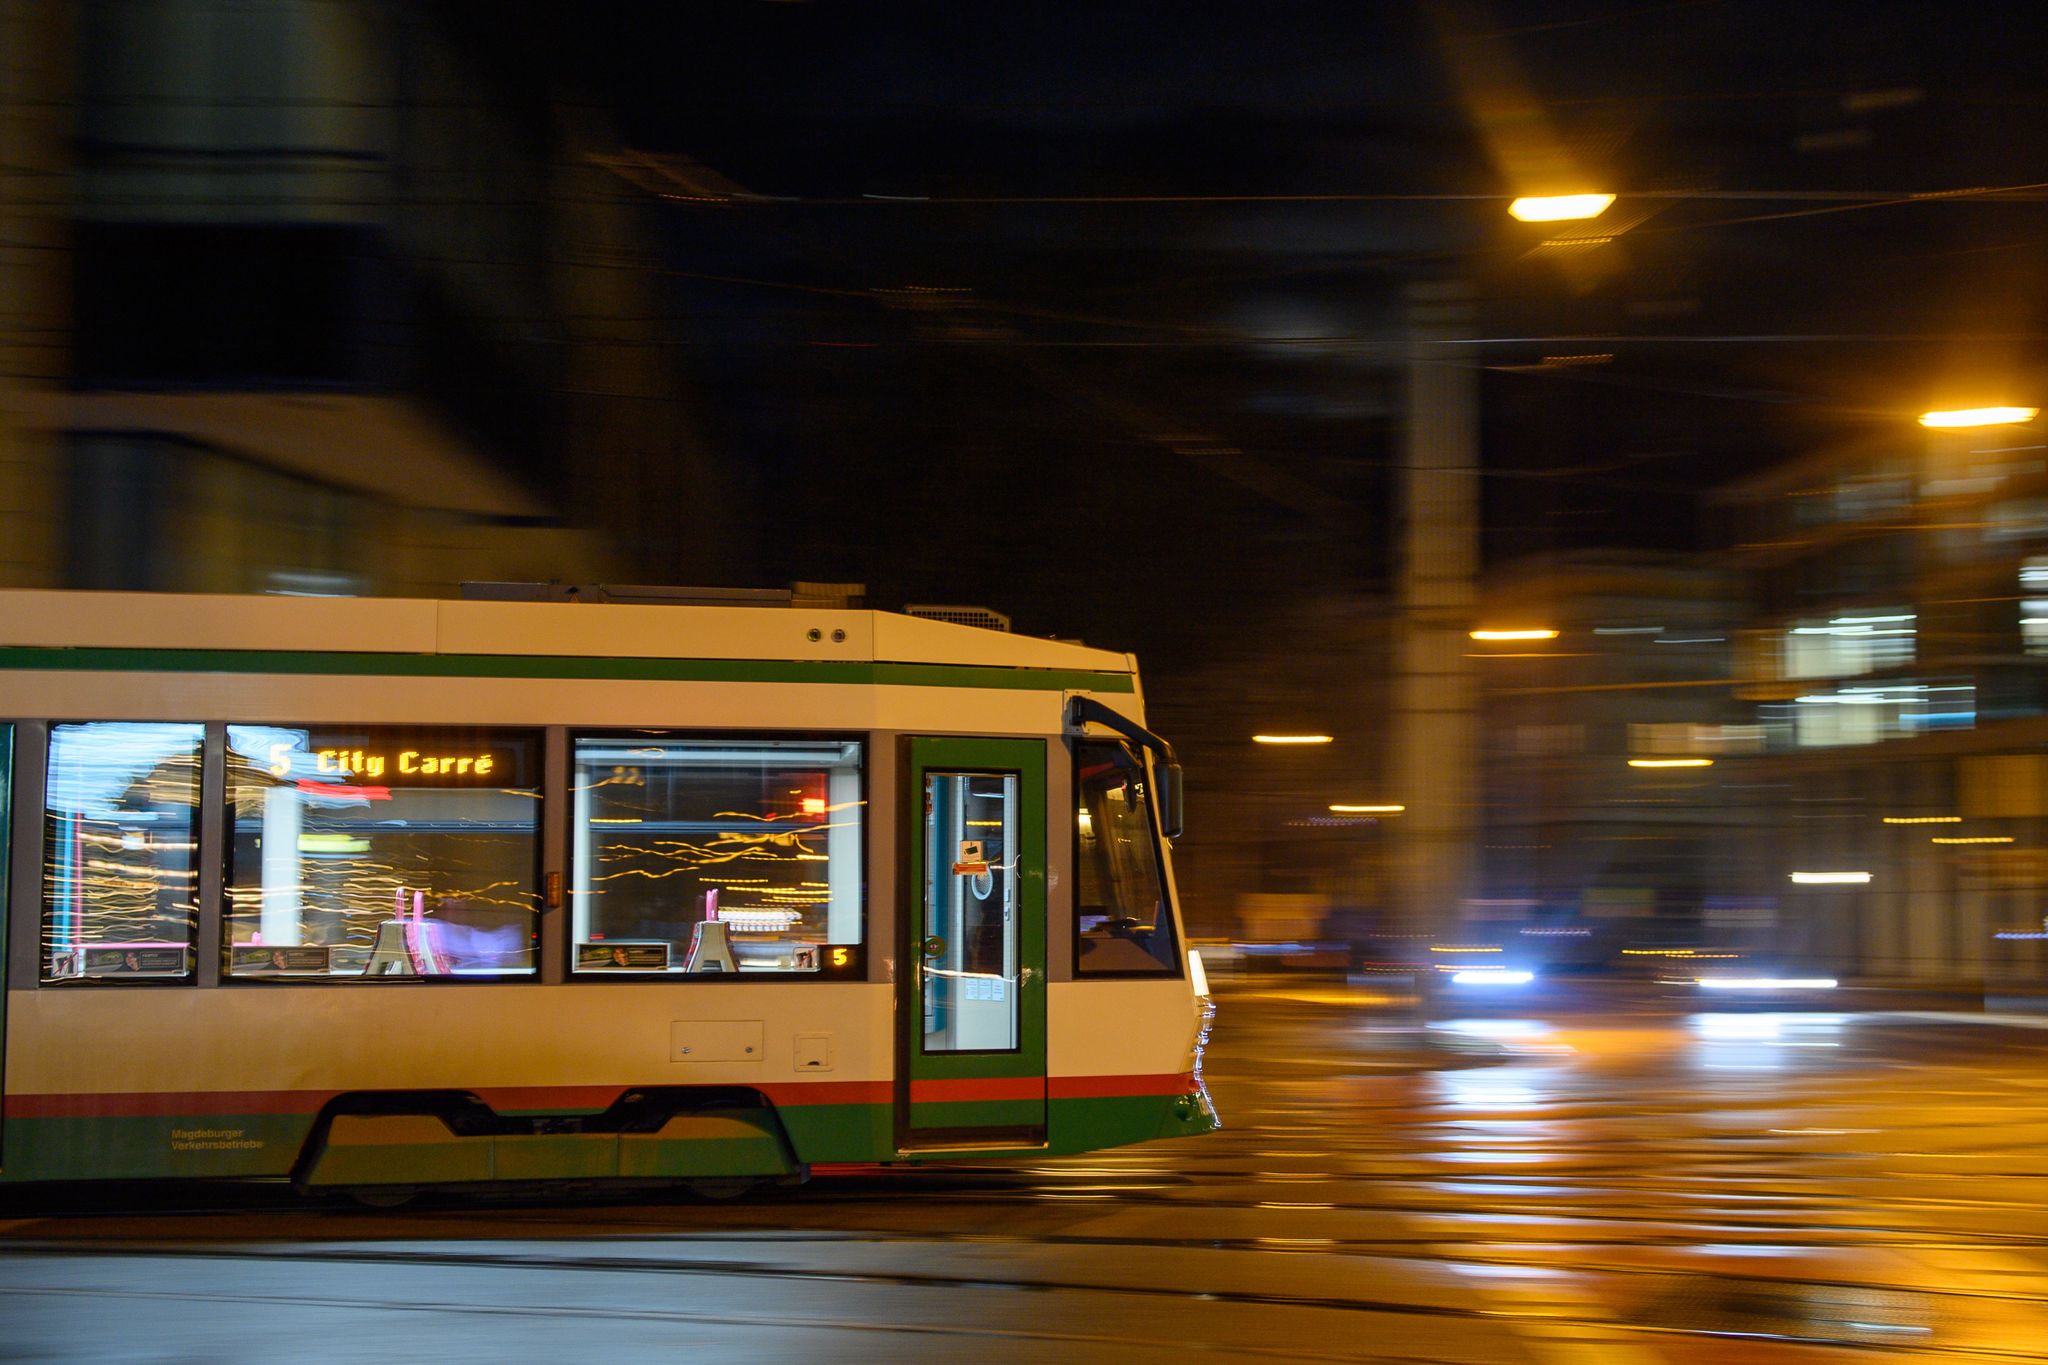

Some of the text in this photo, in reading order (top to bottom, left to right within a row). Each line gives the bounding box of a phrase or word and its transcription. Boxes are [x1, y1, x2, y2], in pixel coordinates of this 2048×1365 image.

[270, 744, 493, 777] 5 City Carré
[833, 948, 847, 966] 5
[171, 1129, 244, 1140] Magdeburger
[171, 1140, 264, 1151] Verkehrsbetriebe
